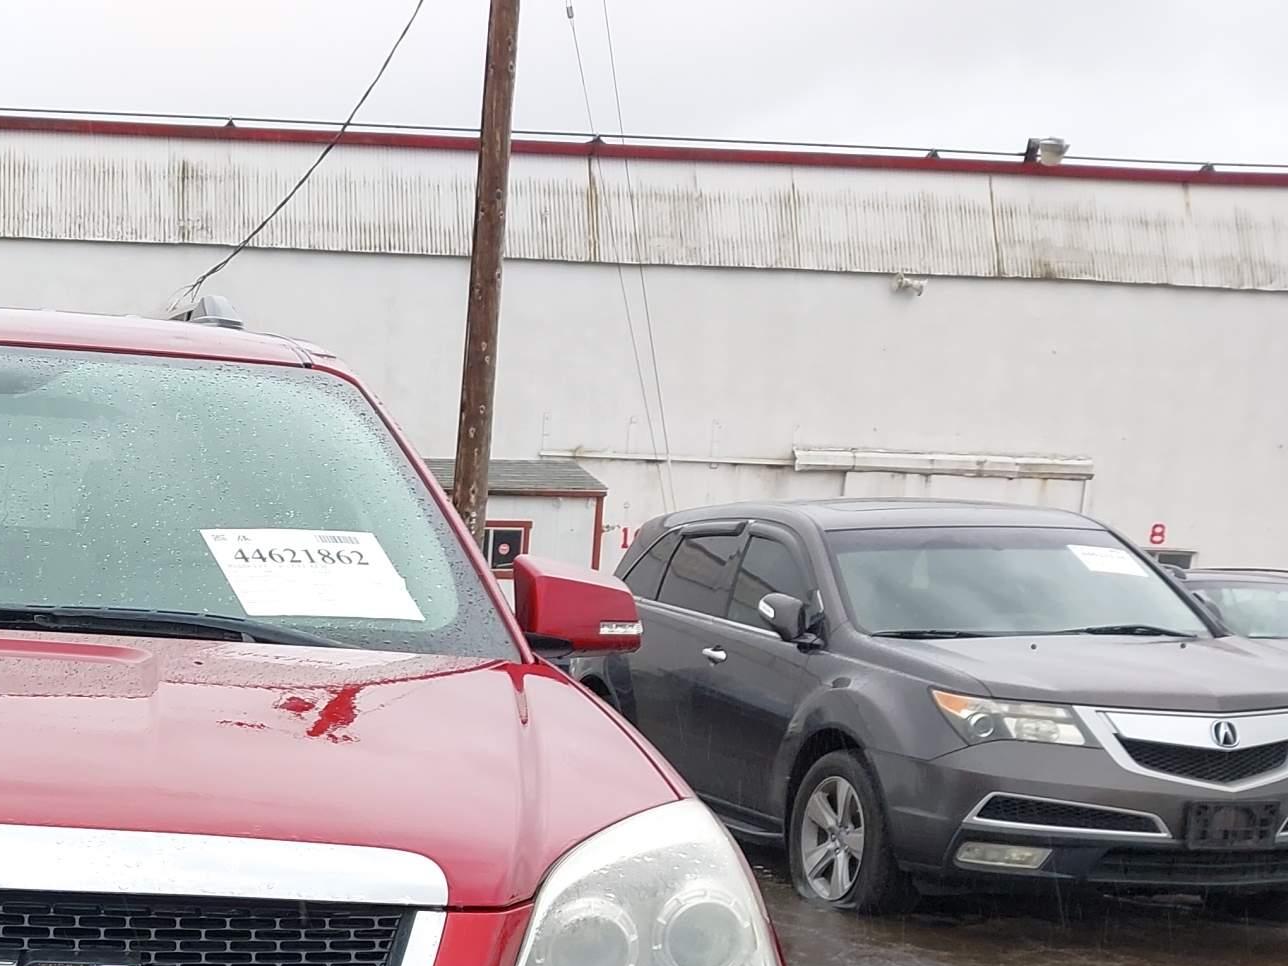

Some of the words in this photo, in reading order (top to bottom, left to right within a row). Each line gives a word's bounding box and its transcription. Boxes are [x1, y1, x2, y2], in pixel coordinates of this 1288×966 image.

[621, 527, 640, 549] 1
[1149, 523, 1165, 544] 8
[234, 547, 369, 566] 44621862
